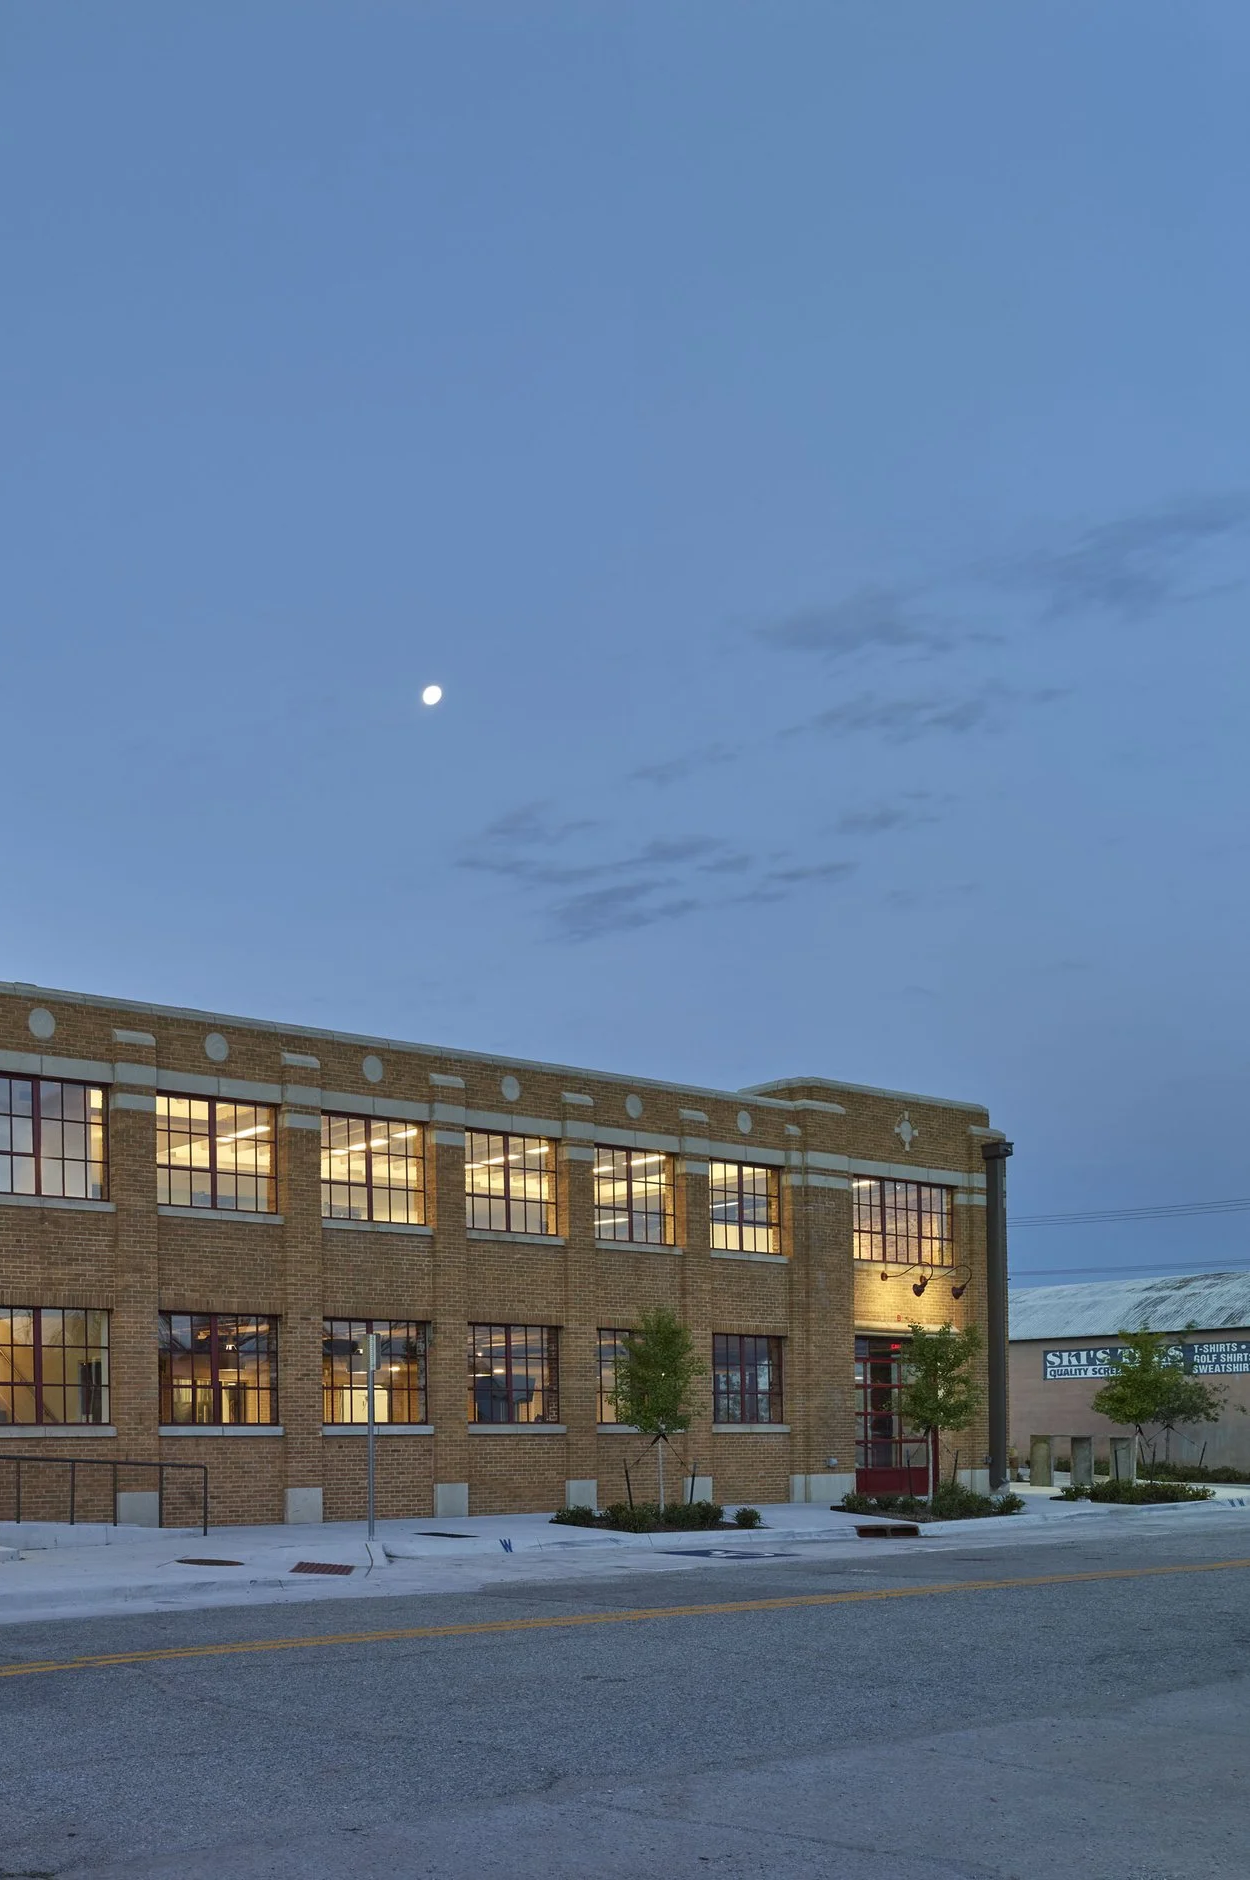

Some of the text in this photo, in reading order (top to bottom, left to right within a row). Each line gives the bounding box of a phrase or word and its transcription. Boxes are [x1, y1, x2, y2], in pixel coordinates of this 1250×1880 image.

[1193, 1343, 1238, 1353] T-SHIRTS
[1046, 1349, 1111, 1367] SKI'S
[1193, 1354, 1217, 1363] GOLF
[1049, 1367, 1088, 1377] QUALITY
[1192, 1363, 1250, 1374] SWEATSHIR
[499, 1538, 513, 1553] W
